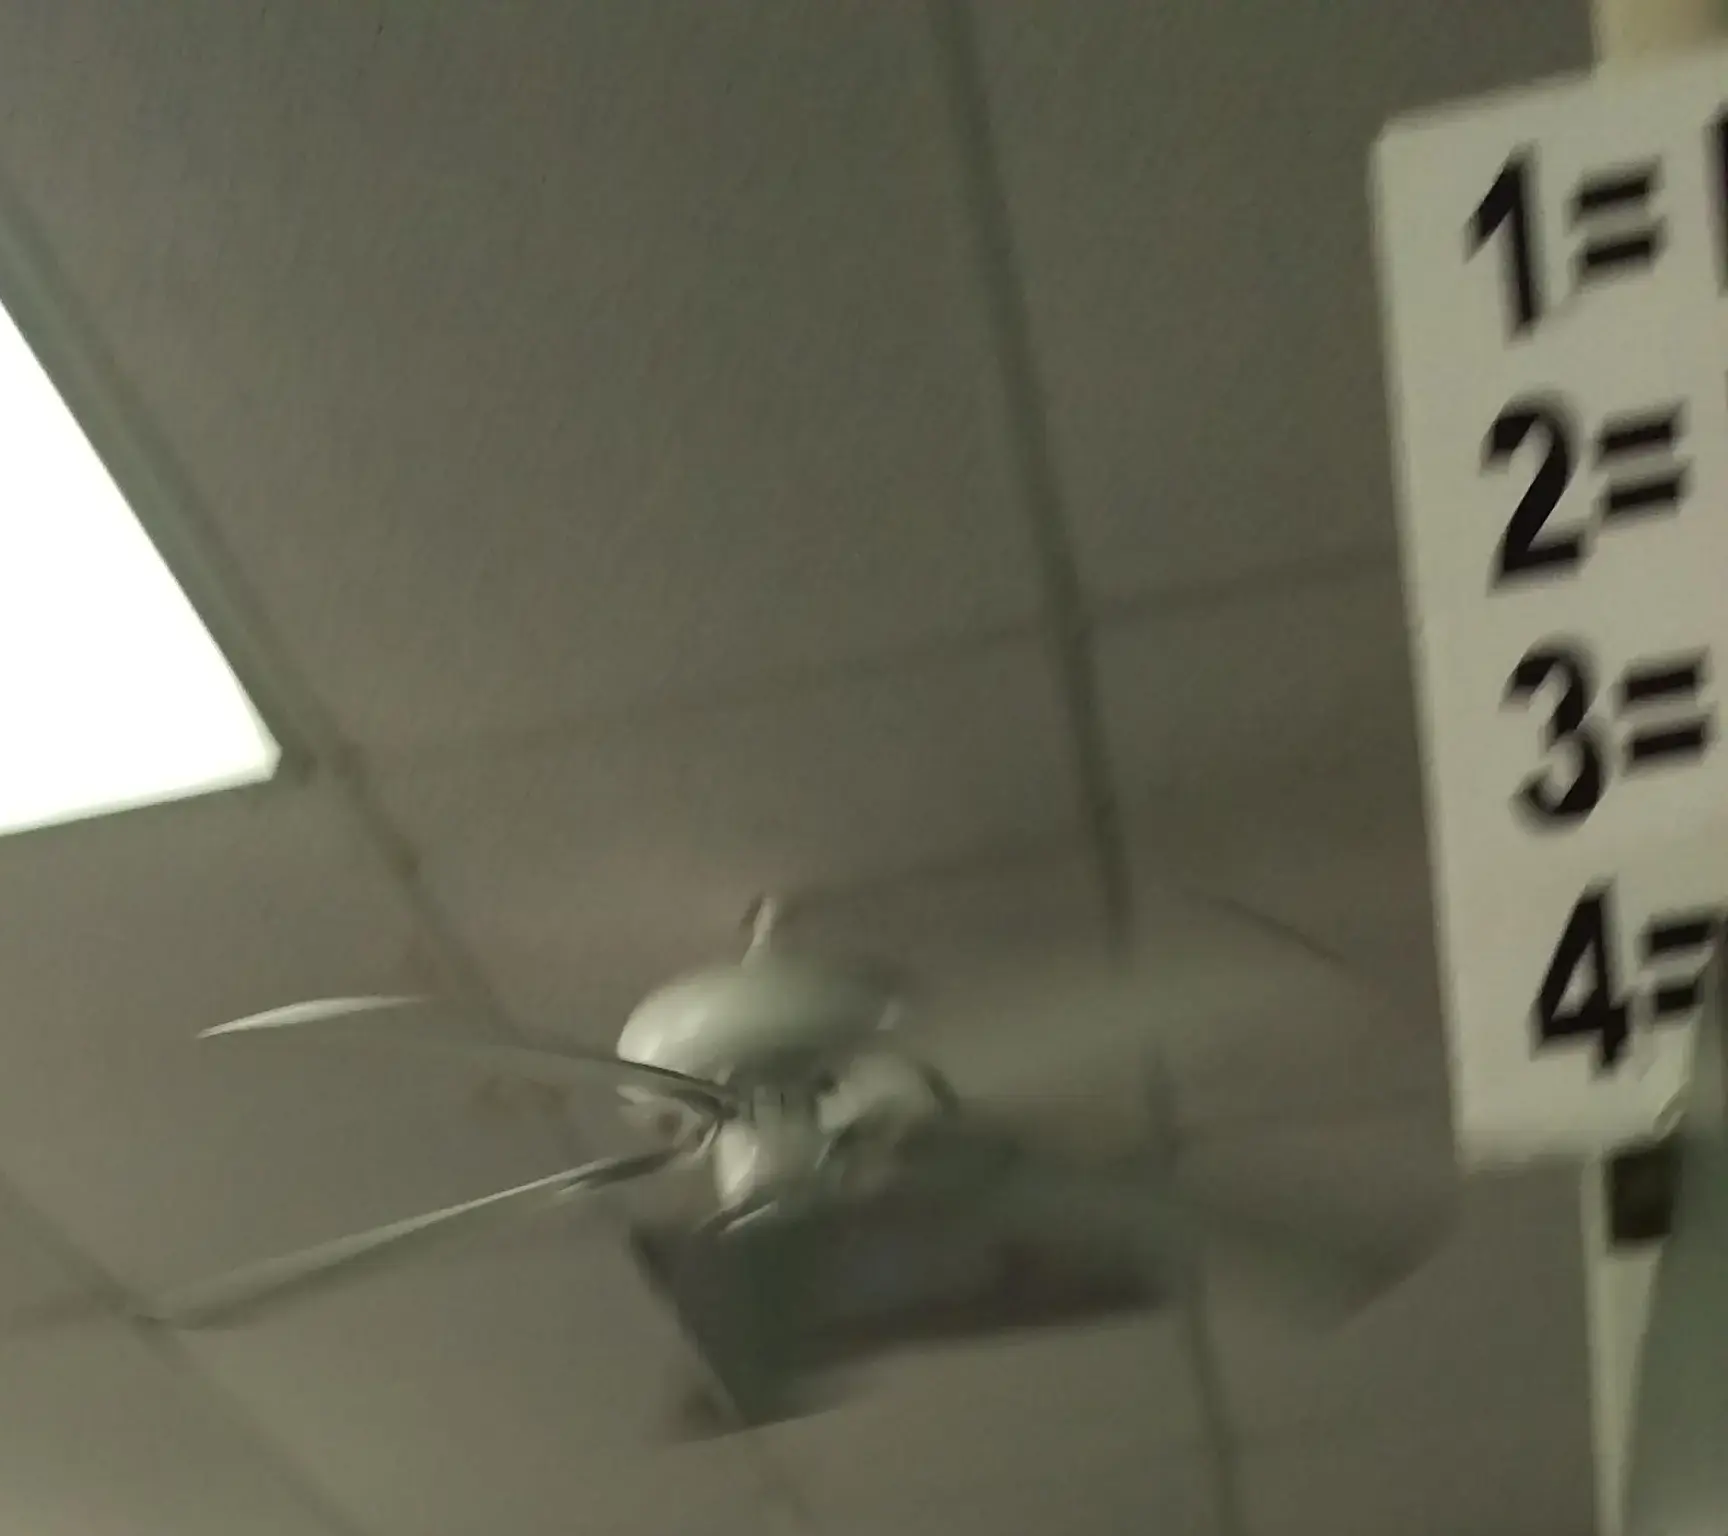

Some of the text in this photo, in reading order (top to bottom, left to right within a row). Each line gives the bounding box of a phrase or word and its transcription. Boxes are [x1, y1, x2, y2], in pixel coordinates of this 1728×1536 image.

[1467, 142, 1665, 342] 1=
[1482, 388, 1692, 592] 2=
[1500, 634, 1718, 834] 3=
